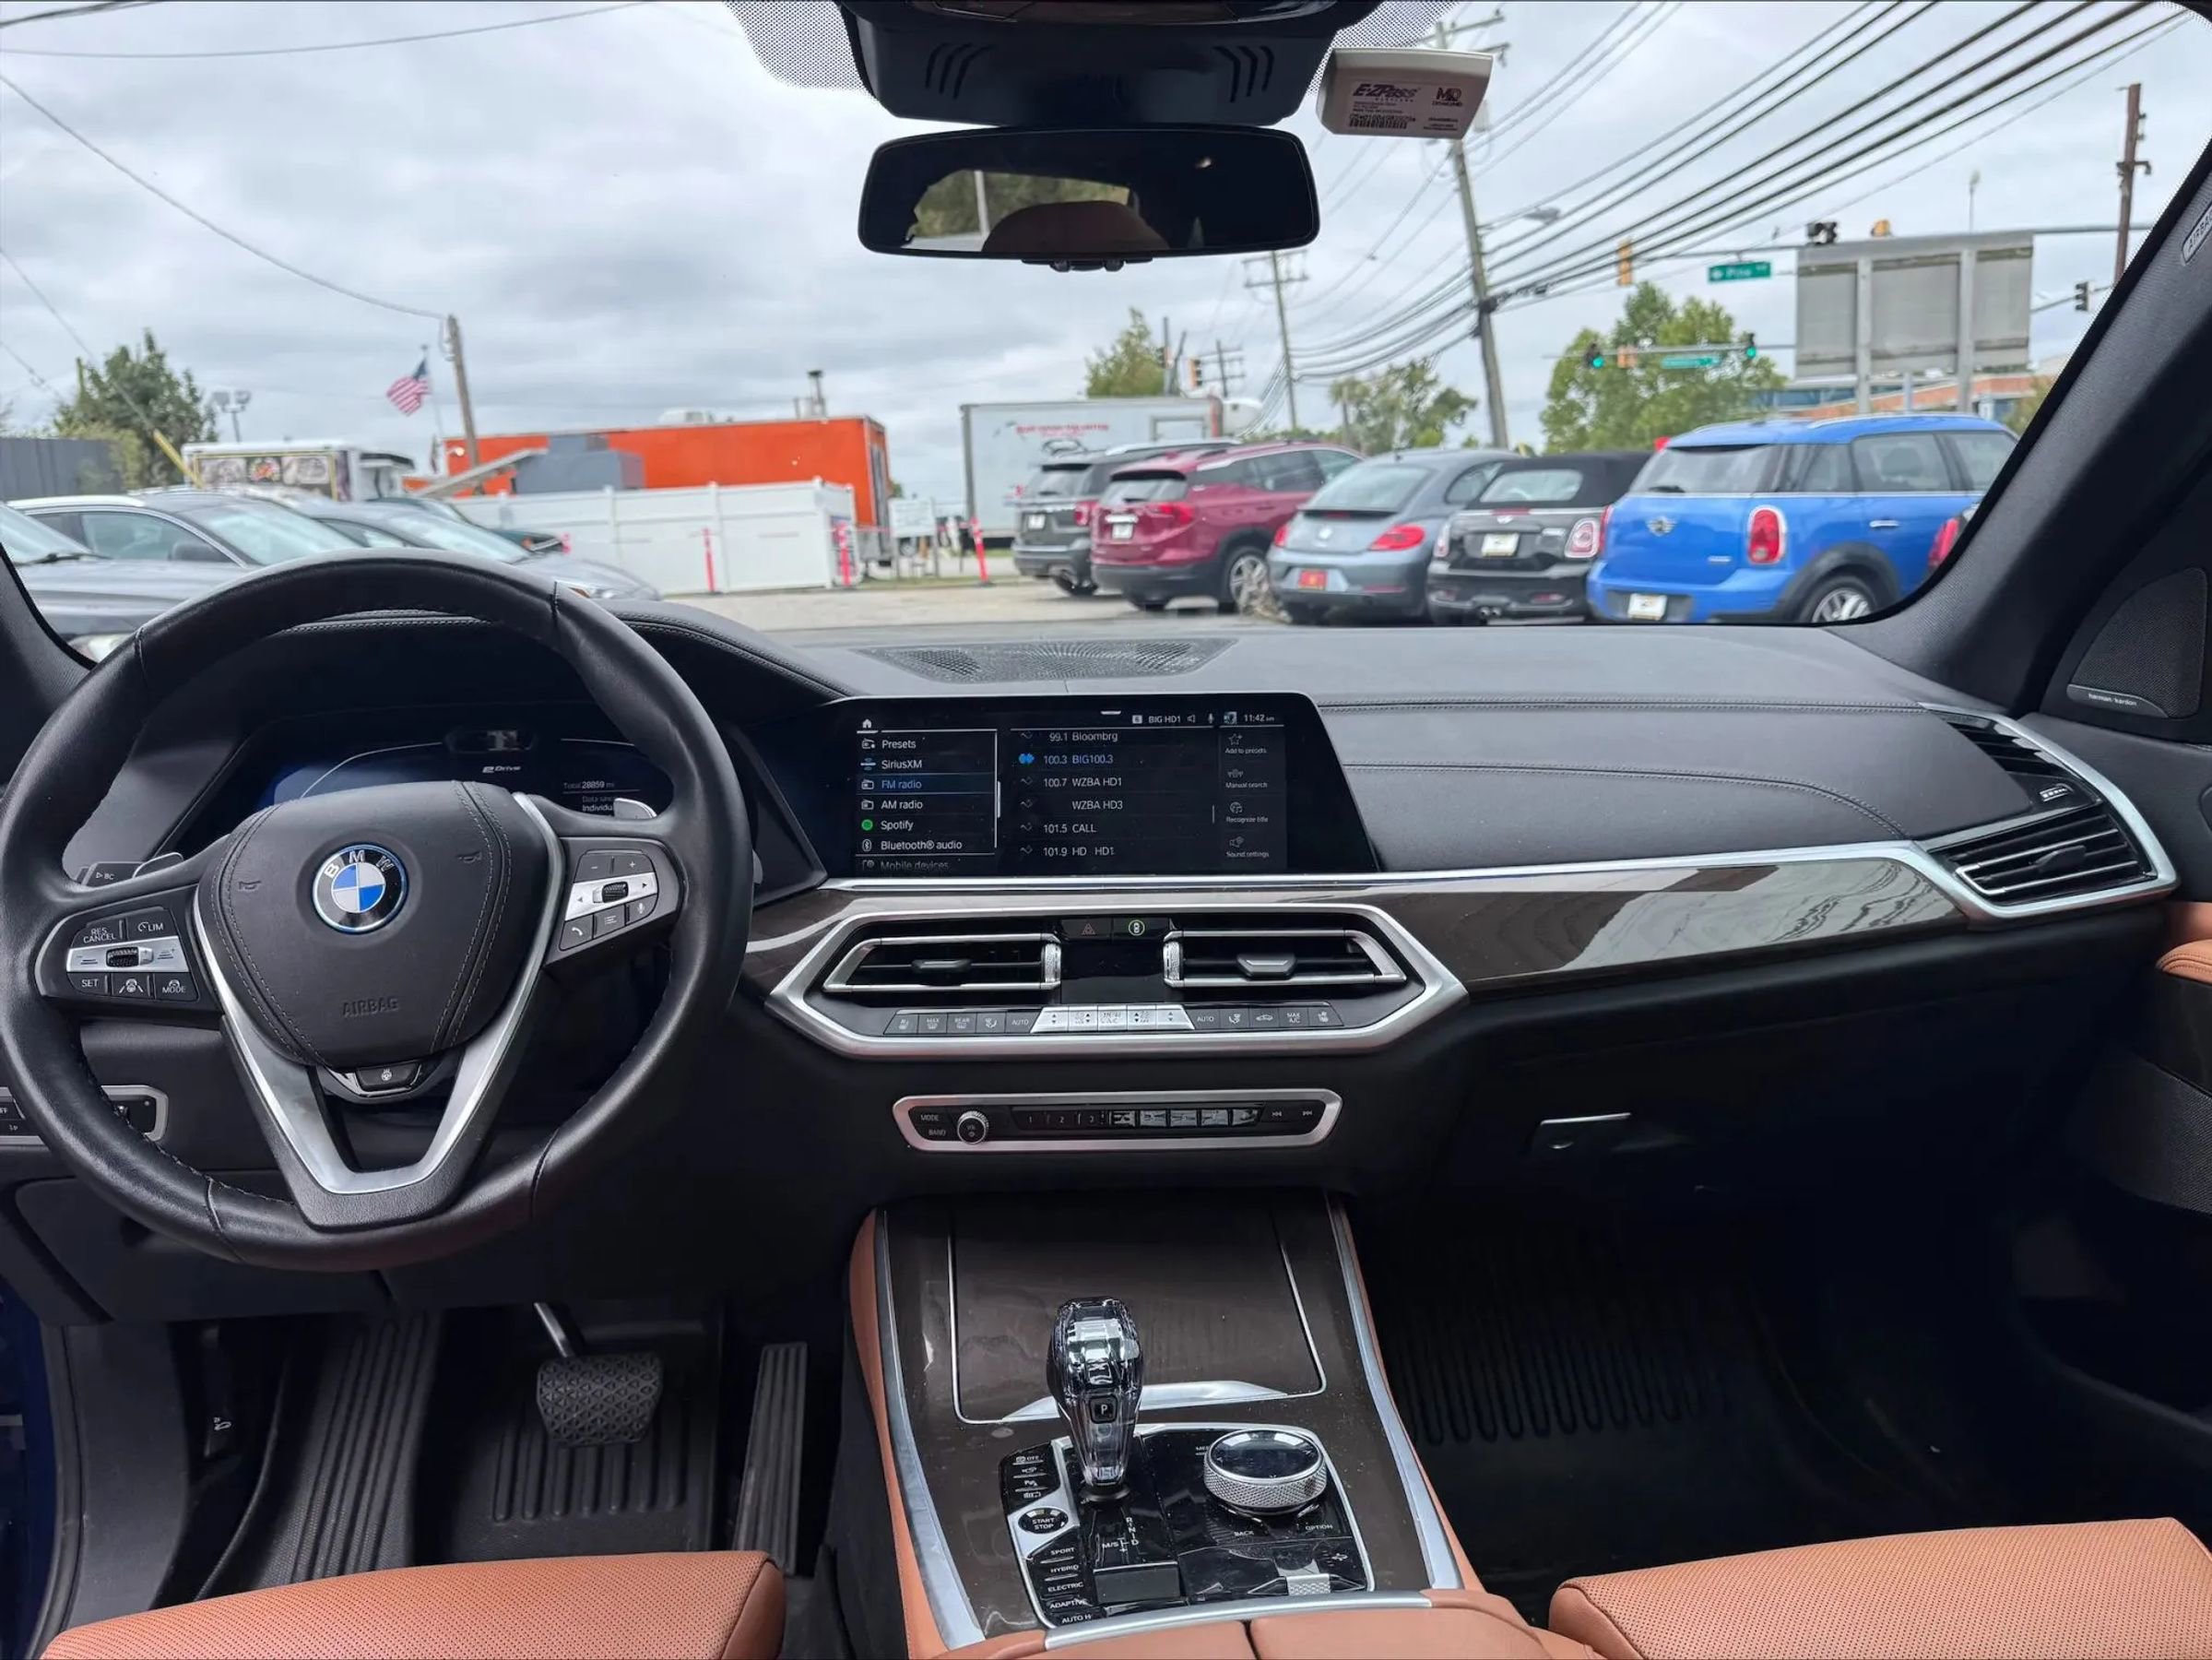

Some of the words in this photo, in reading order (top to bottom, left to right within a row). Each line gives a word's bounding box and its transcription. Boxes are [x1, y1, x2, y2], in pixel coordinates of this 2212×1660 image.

[1244, 714, 1265, 722] 11:42
[1049, 732, 1068, 741] 99.1
[1072, 731, 1118, 741] Bloombrg
[881, 740, 917, 749] Presets
[881, 760, 923, 769] SiriusXM
[1044, 755, 1068, 765] 100.3
[881, 780, 896, 788] FM
[898, 779, 922, 788] radio
[1044, 778, 1068, 788] 100.7
[1072, 778, 1101, 787] WZBA
[1103, 777, 1122, 787] HD1
[881, 800, 896, 809] AM
[899, 800, 923, 809] radio
[1072, 800, 1101, 810] WZBA
[1103, 800, 1123, 809] HD3
[881, 820, 914, 831] Spotify
[1044, 824, 1068, 834] 101.5
[1072, 824, 1097, 833] CALL
[936, 841, 963, 849] audio
[1044, 848, 1068, 857] 101.9
[1072, 847, 1087, 856] HD
[324, 849, 396, 880] BMW
[881, 860, 912, 870] Mobile
[915, 860, 949, 870] devices
[90, 927, 108, 935] RES
[148, 923, 164, 931] LIM
[83, 933, 116, 943] CANCEL
[81, 978, 99, 988] SET
[342, 997, 399, 1017] AIRBAG
[1101, 1404, 1108, 1415] P
[1050, 1547, 1075, 1556] SPORT
[1050, 1564, 1080, 1573] HYBRID
[1047, 1582, 1084, 1593] ELECTRIC
[1049, 1597, 1088, 1609] ADAPTIVE
[1061, 1615, 1083, 1624] AUTO
